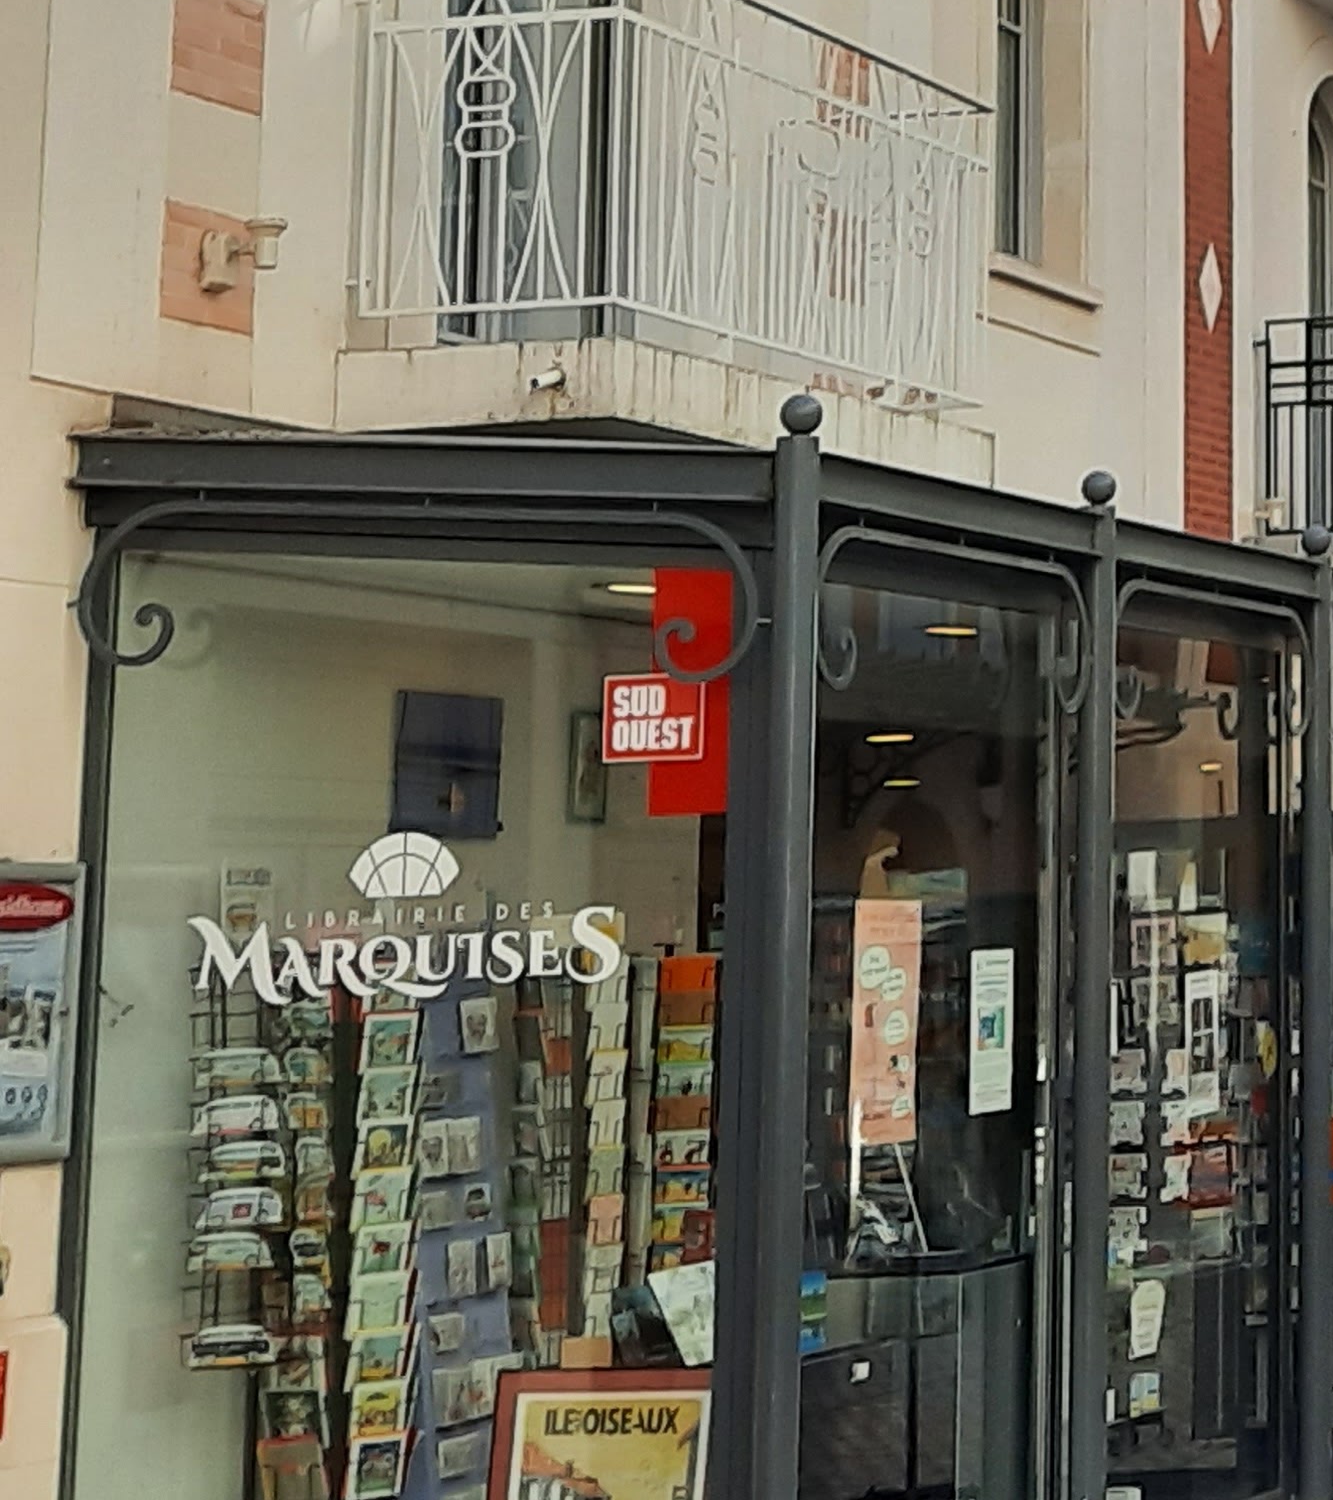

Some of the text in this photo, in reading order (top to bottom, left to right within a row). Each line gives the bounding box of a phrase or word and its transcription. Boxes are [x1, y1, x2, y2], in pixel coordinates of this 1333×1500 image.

[613, 684, 667, 718] SUD
[611, 716, 694, 752] OUEST
[284, 901, 554, 930] LIBRAIRIE DES
[187, 906, 621, 1005] MARQUISES
[583, 1406, 680, 1435] OISEAUX
